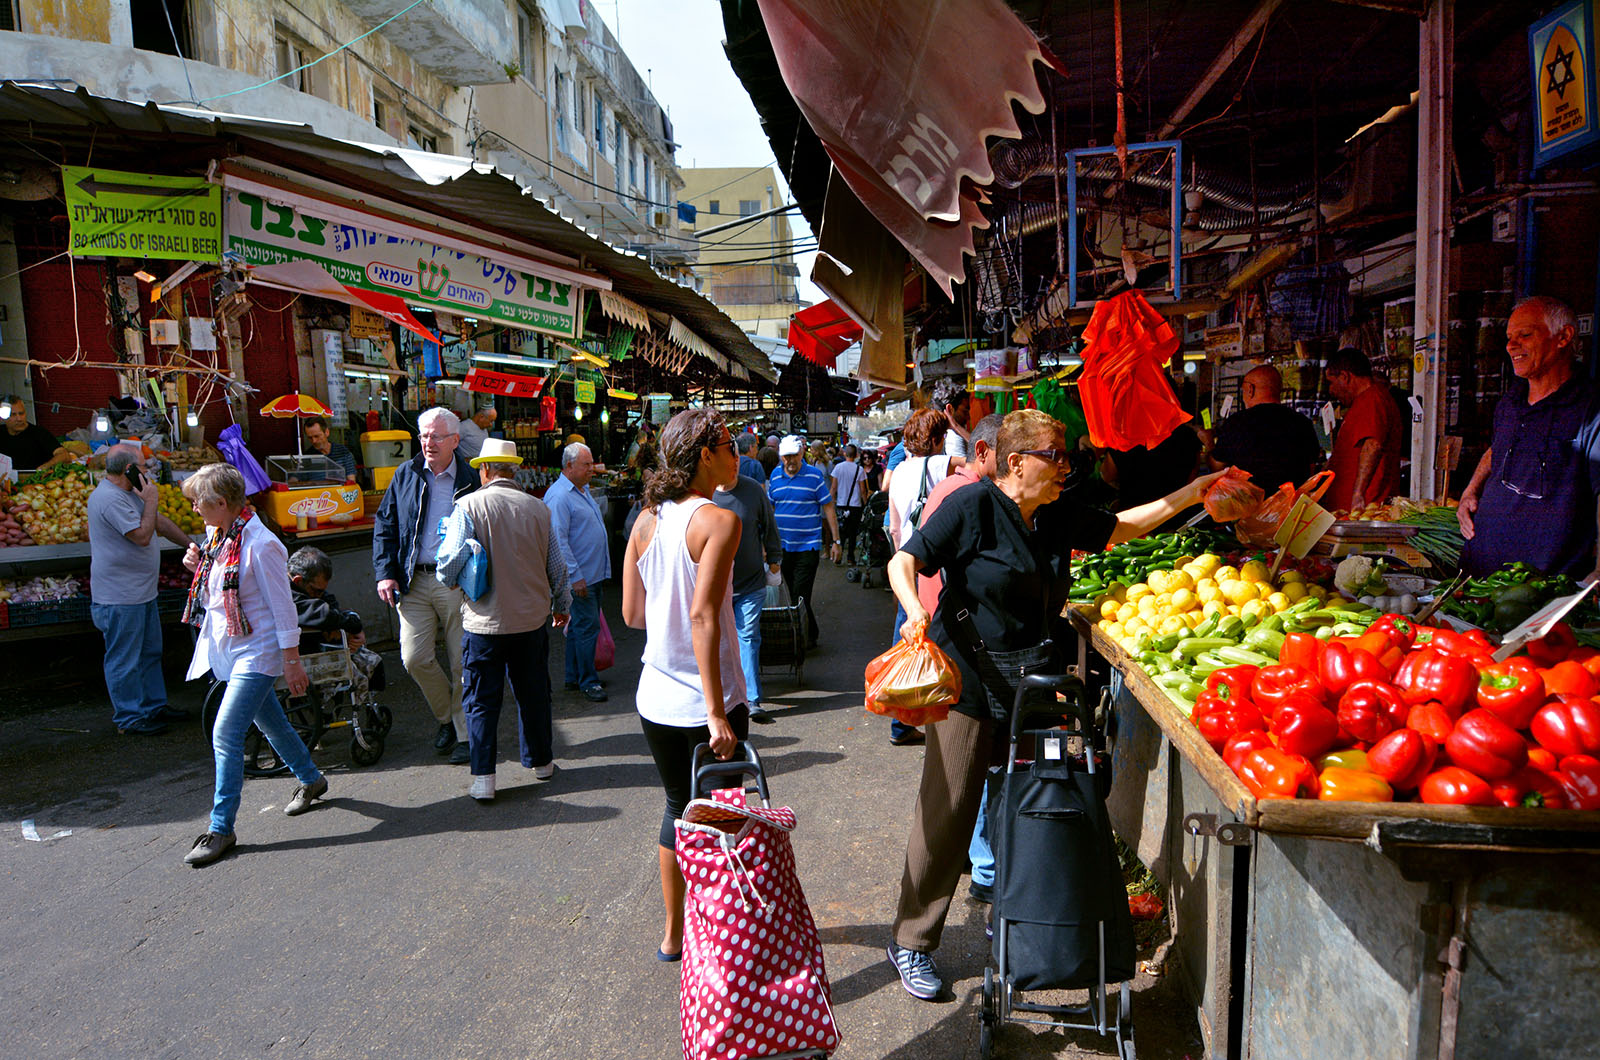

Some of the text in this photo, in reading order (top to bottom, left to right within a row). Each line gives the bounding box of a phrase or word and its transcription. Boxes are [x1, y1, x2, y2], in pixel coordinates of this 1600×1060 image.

[73, 202, 134, 225] ישראלית
[168, 207, 195, 226] סוגי
[199, 211, 216, 227] 80
[238, 192, 328, 247] צבר
[74, 231, 218, 255] 80 KINDS OF ISRAELI BEER
[374, 266, 413, 286] שמאי
[447, 284, 485, 304] האחים
[521, 271, 572, 307] צבר
[499, 304, 516, 317] צבר
[518, 308, 540, 322] סלטי
[560, 315, 570, 329] כל
[474, 375, 508, 390] לפסח
[393, 441, 404, 458] 2
